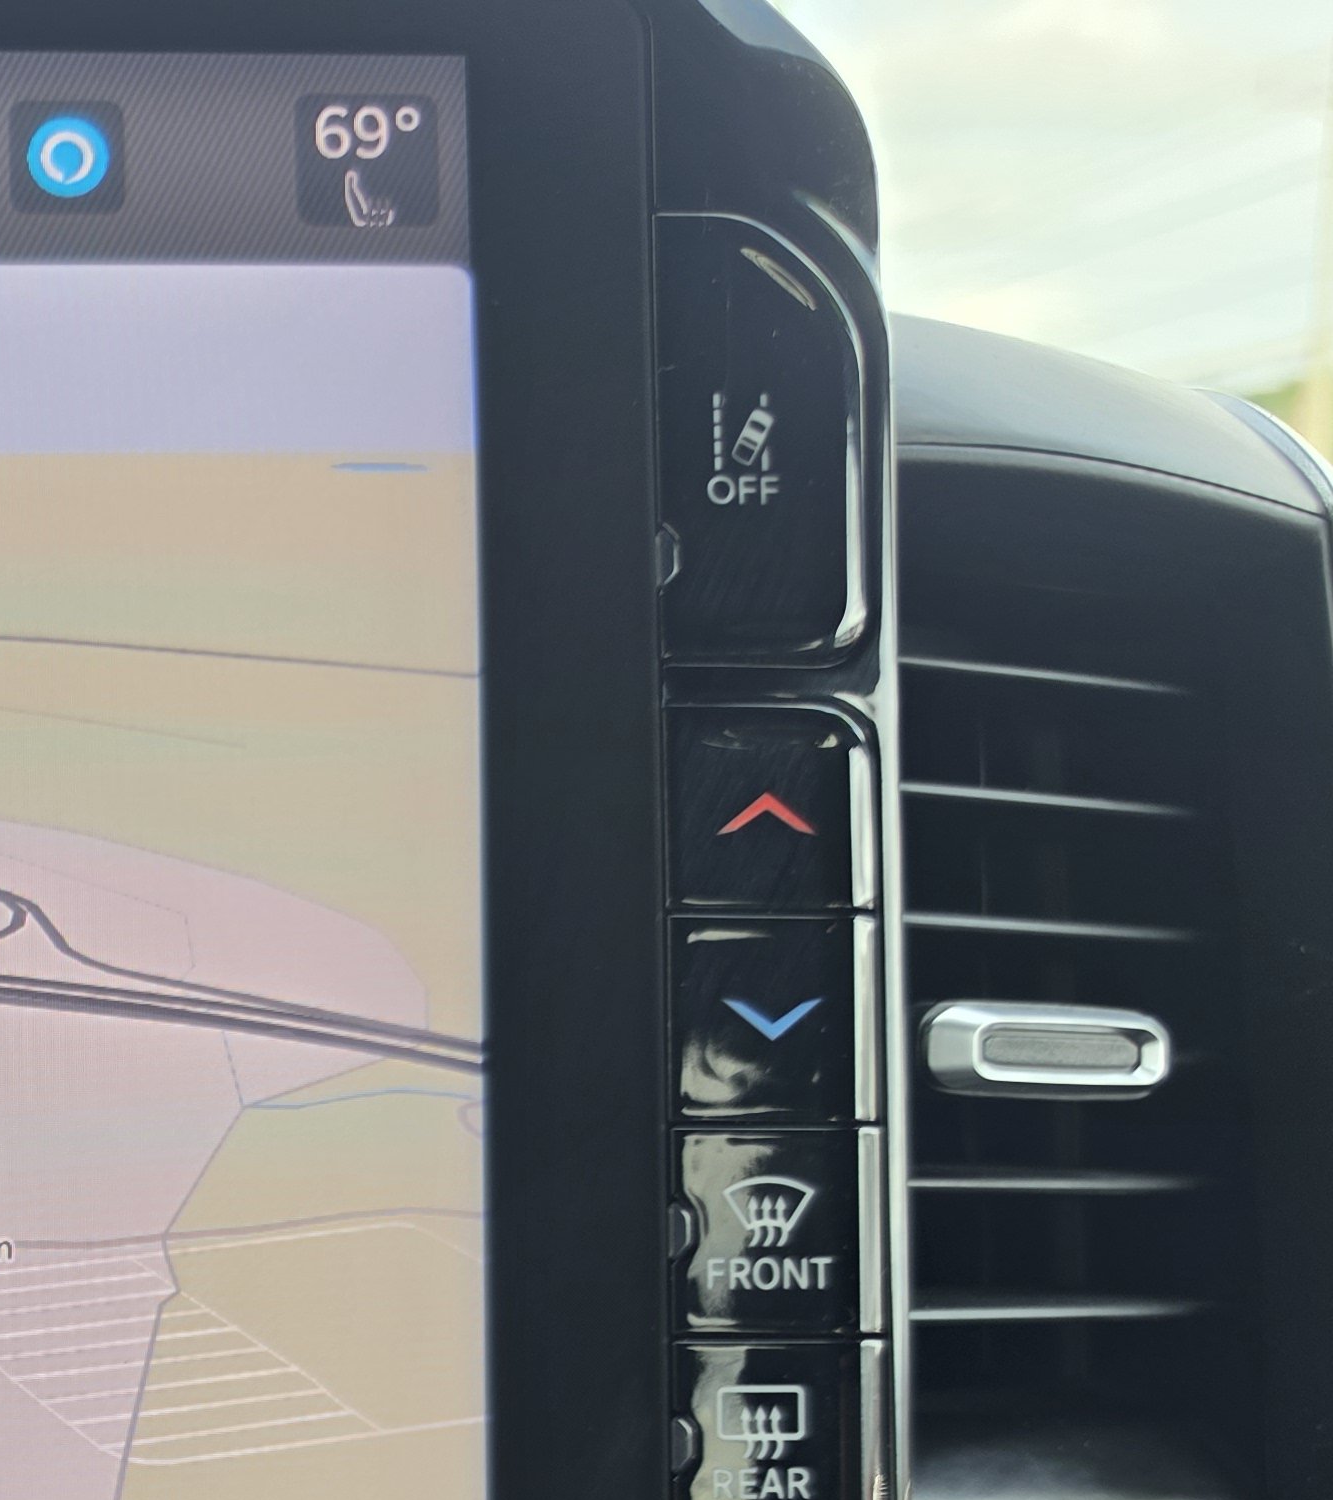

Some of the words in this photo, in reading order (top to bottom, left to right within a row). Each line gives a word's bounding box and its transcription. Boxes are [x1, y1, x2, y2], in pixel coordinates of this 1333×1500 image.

[314, 105, 421, 160] 69°
[707, 474, 780, 506] OFF
[706, 1256, 833, 1291] FRONT
[713, 1469, 811, 1500] REAR
